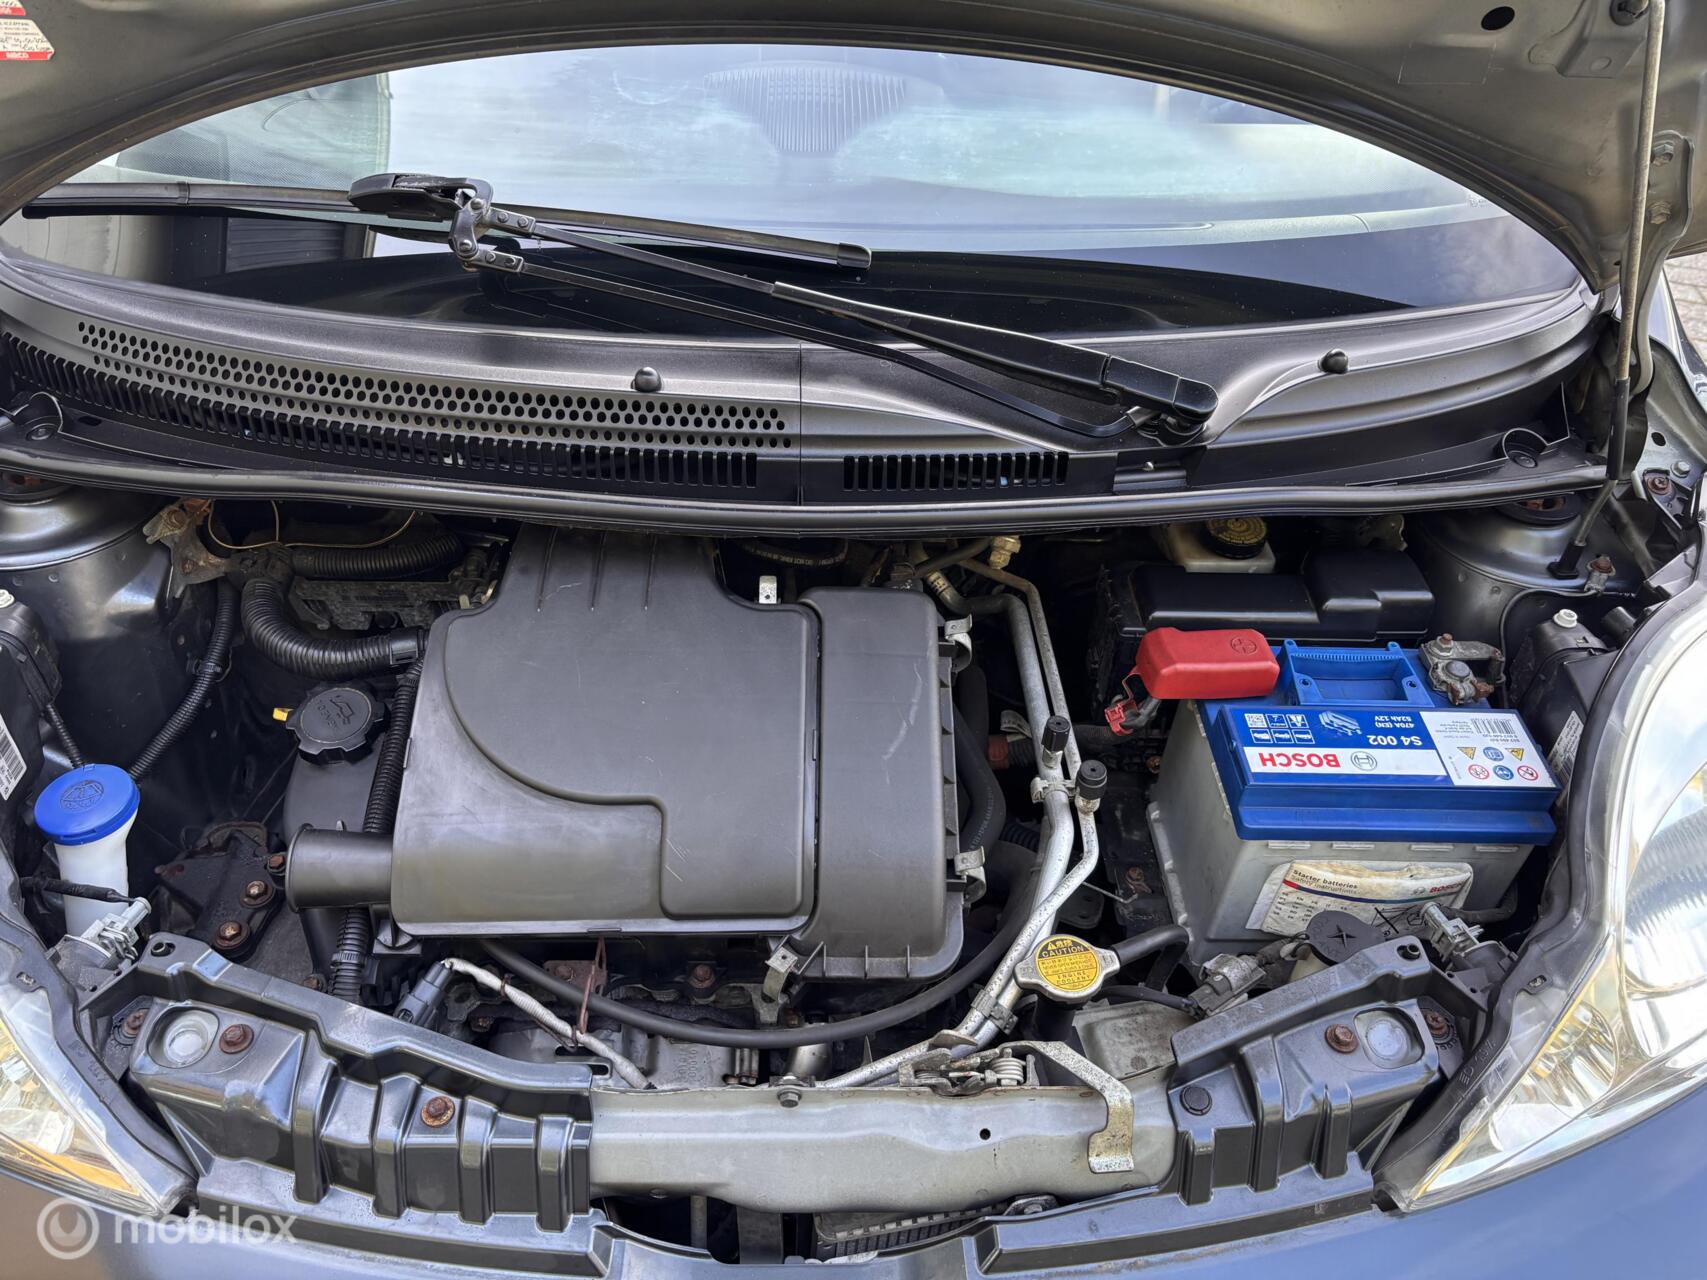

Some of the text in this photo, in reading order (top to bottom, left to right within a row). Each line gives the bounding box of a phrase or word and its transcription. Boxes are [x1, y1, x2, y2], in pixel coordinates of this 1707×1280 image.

[1366, 735, 1423, 746] S4 002
[1257, 752, 1341, 768] BOSCH
[1293, 869, 1358, 889] Starter batteries
[1429, 881, 1462, 894] BOSCH
[1042, 945, 1083, 957] CAUTION
